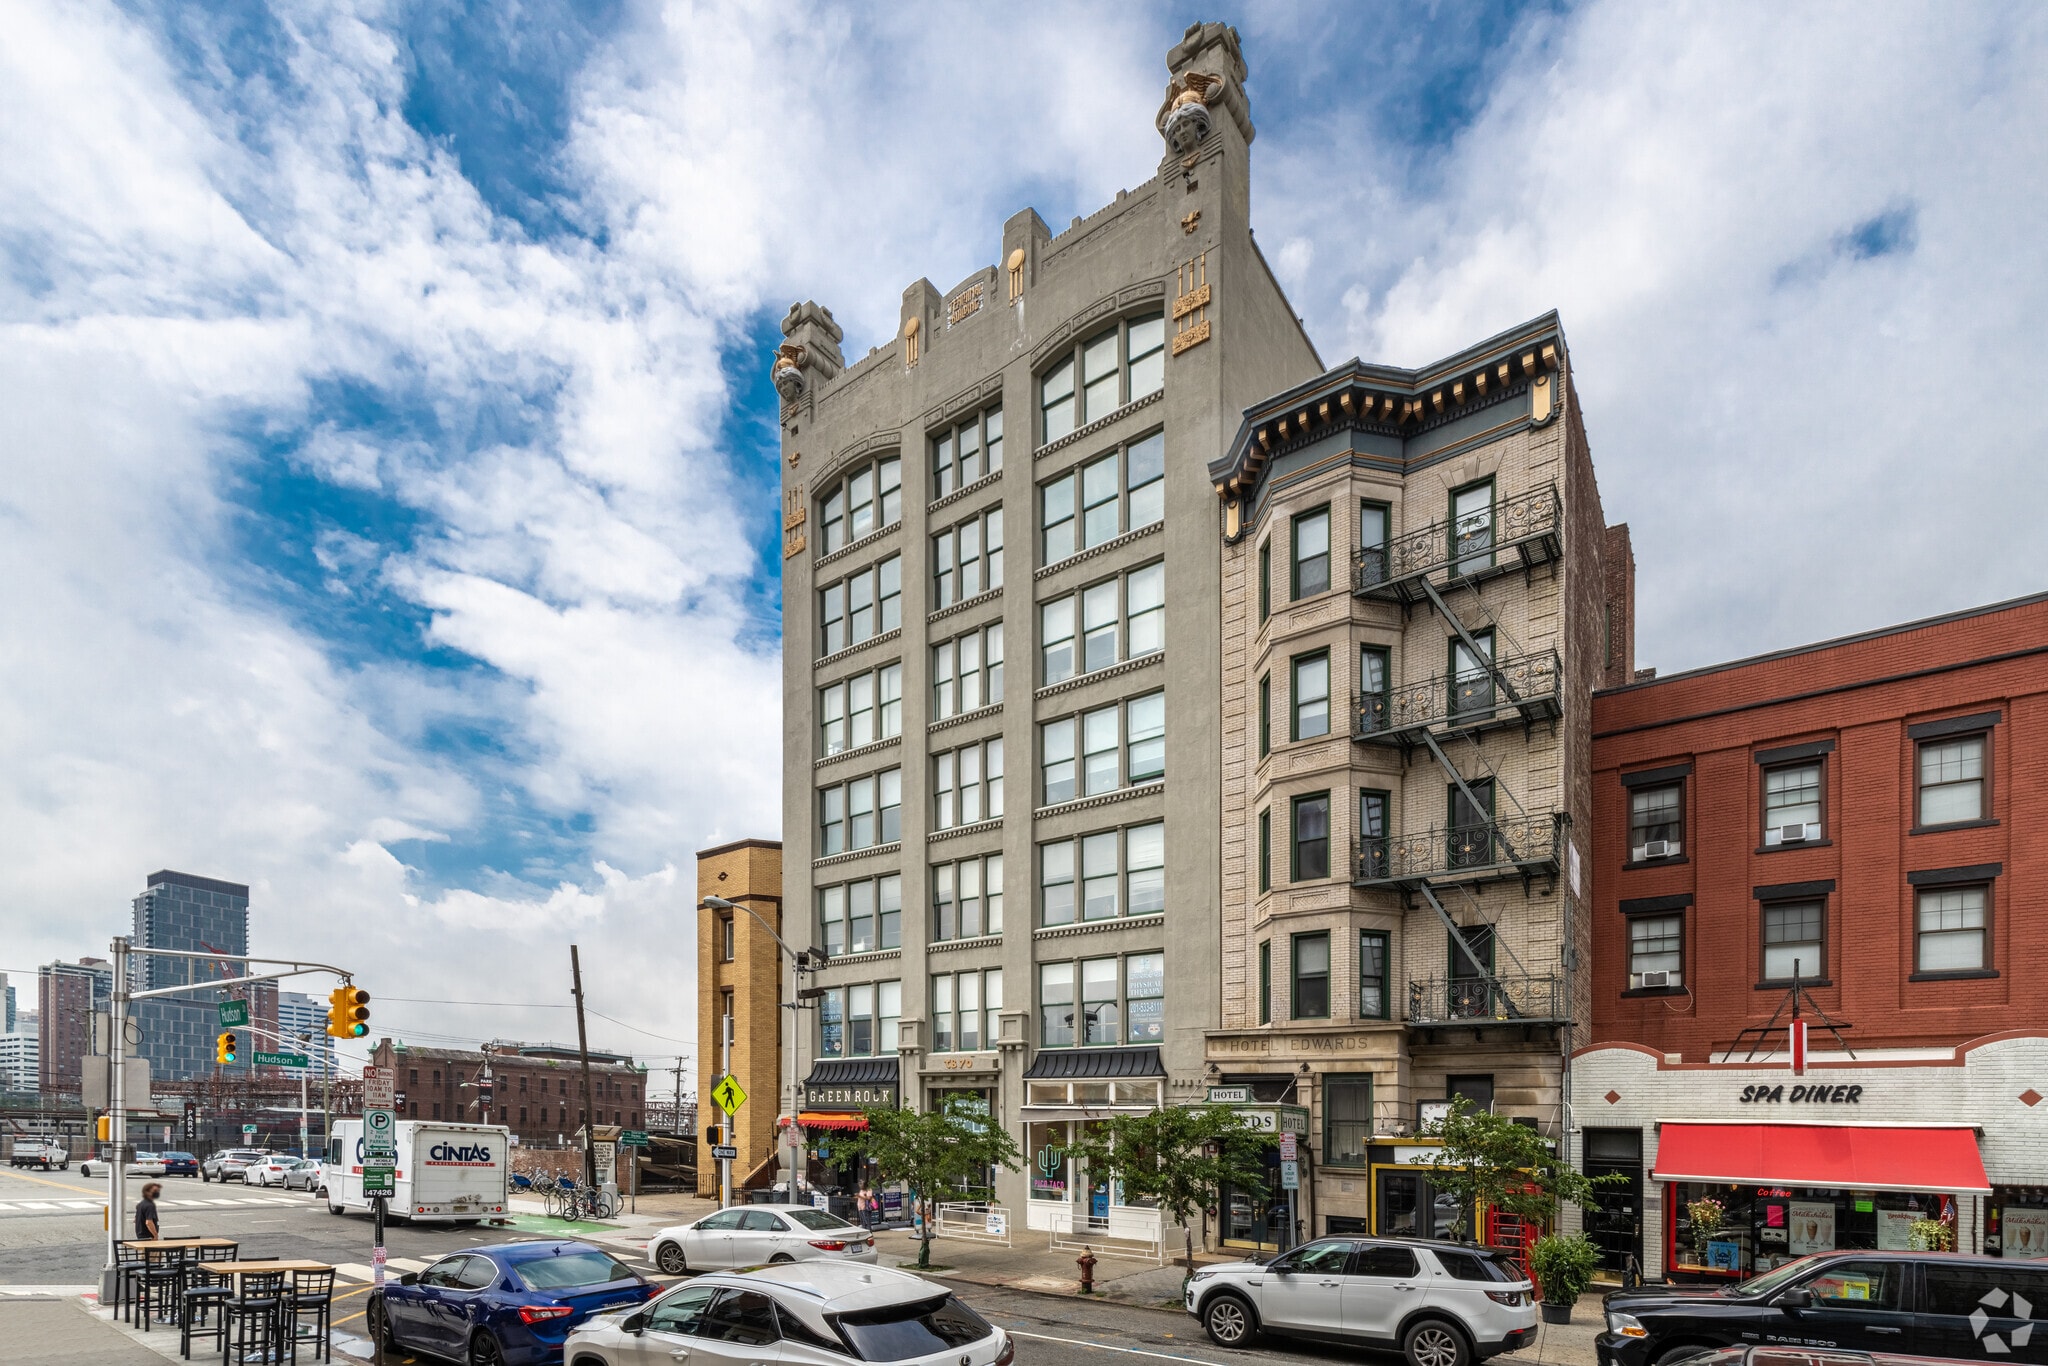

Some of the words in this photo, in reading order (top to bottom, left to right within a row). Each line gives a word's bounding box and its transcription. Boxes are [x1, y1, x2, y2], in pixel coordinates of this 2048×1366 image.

[1130, 980, 1161, 989] PHYSICAL
[1130, 987, 1160, 996] THERAPY
[220, 1006, 241, 1023] Hudson
[1230, 1038, 1279, 1052] HOTEL
[1291, 1037, 1368, 1051] EDWARDS
[257, 1054, 293, 1065] Hudson
[364, 1068, 376, 1078] NO
[1214, 1091, 1244, 1099] HOTEL
[1739, 1085, 1784, 1103] SPA
[1789, 1085, 1863, 1103] DINER
[375, 1115, 386, 1127] P
[1283, 1116, 1305, 1130] HOTEL
[1050, 1180, 1065, 1189] TACO
[367, 1189, 392, 1197] 47426
[1757, 1187, 1792, 1198] Coffee
[1791, 1210, 1833, 1219] Milkshakes
[1766, 1334, 1801, 1344] RAM
[1803, 1338, 1837, 1348] 1500
